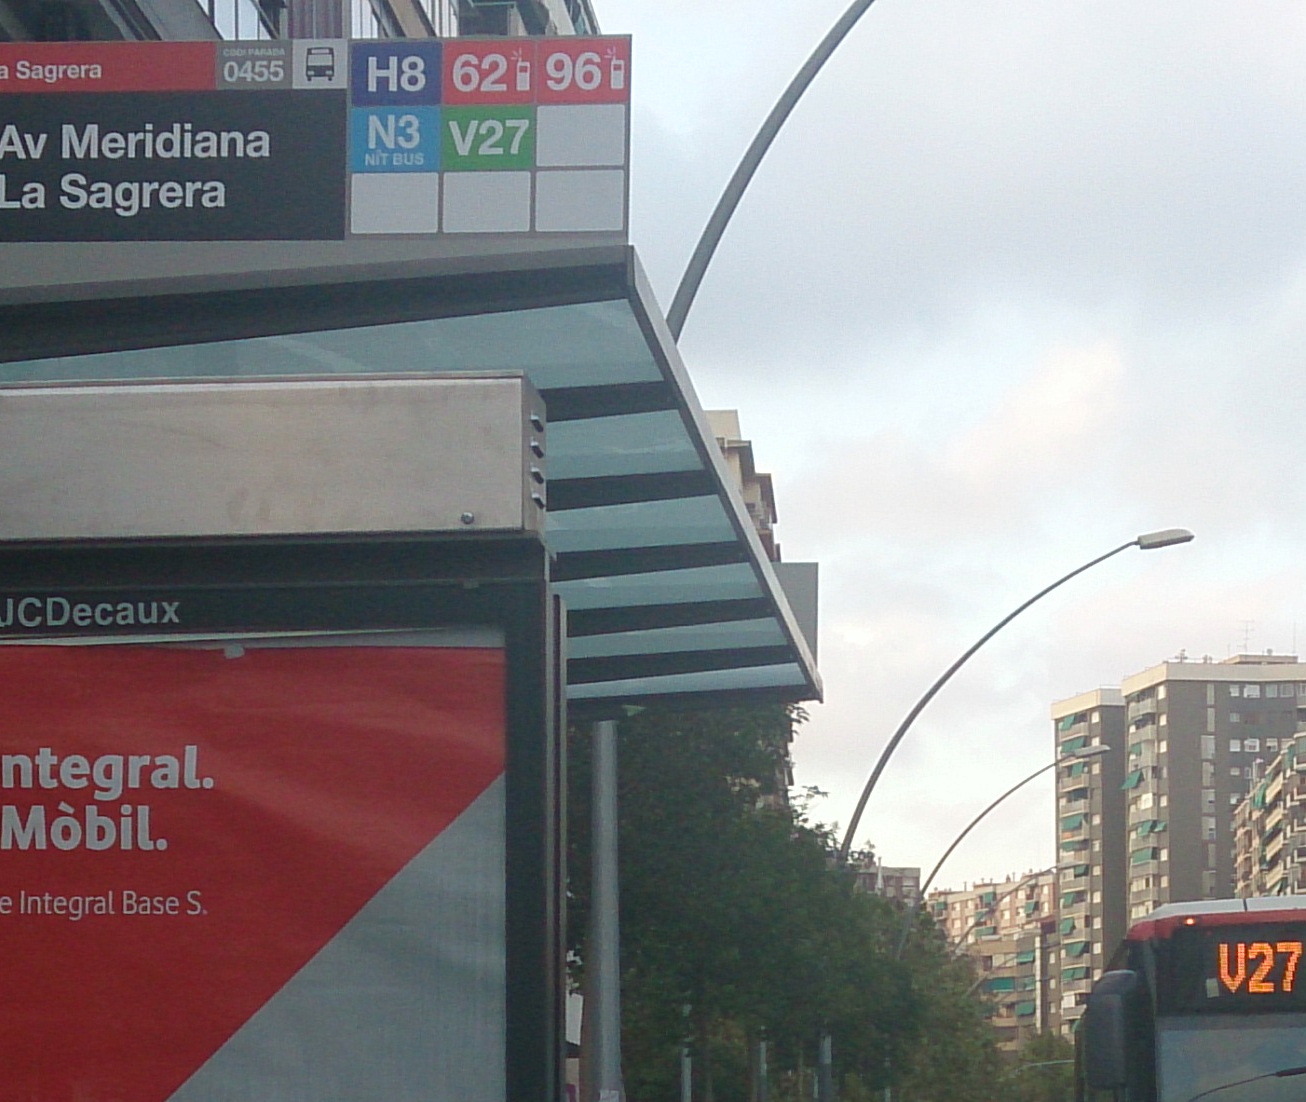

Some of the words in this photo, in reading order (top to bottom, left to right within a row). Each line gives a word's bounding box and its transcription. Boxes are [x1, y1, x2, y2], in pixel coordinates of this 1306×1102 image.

[15, 59, 103, 83] Sagrera
[223, 60, 285, 82] 0455
[367, 55, 427, 93] H8
[452, 53, 508, 93] 62
[545, 52, 602, 92] 96
[61, 122, 271, 159] Meridiana
[367, 114, 421, 150] N3
[448, 118, 530, 156] V27
[364, 152, 391, 166] NIT
[392, 152, 424, 166] BUS
[59, 173, 226, 217] Sagrera
[0, 802, 169, 851] Mòbil.
[18, 890, 115, 921] Integral
[121, 890, 180, 917] Base
[185, 891, 209, 917] S.
[1218, 942, 1303, 993] V27
